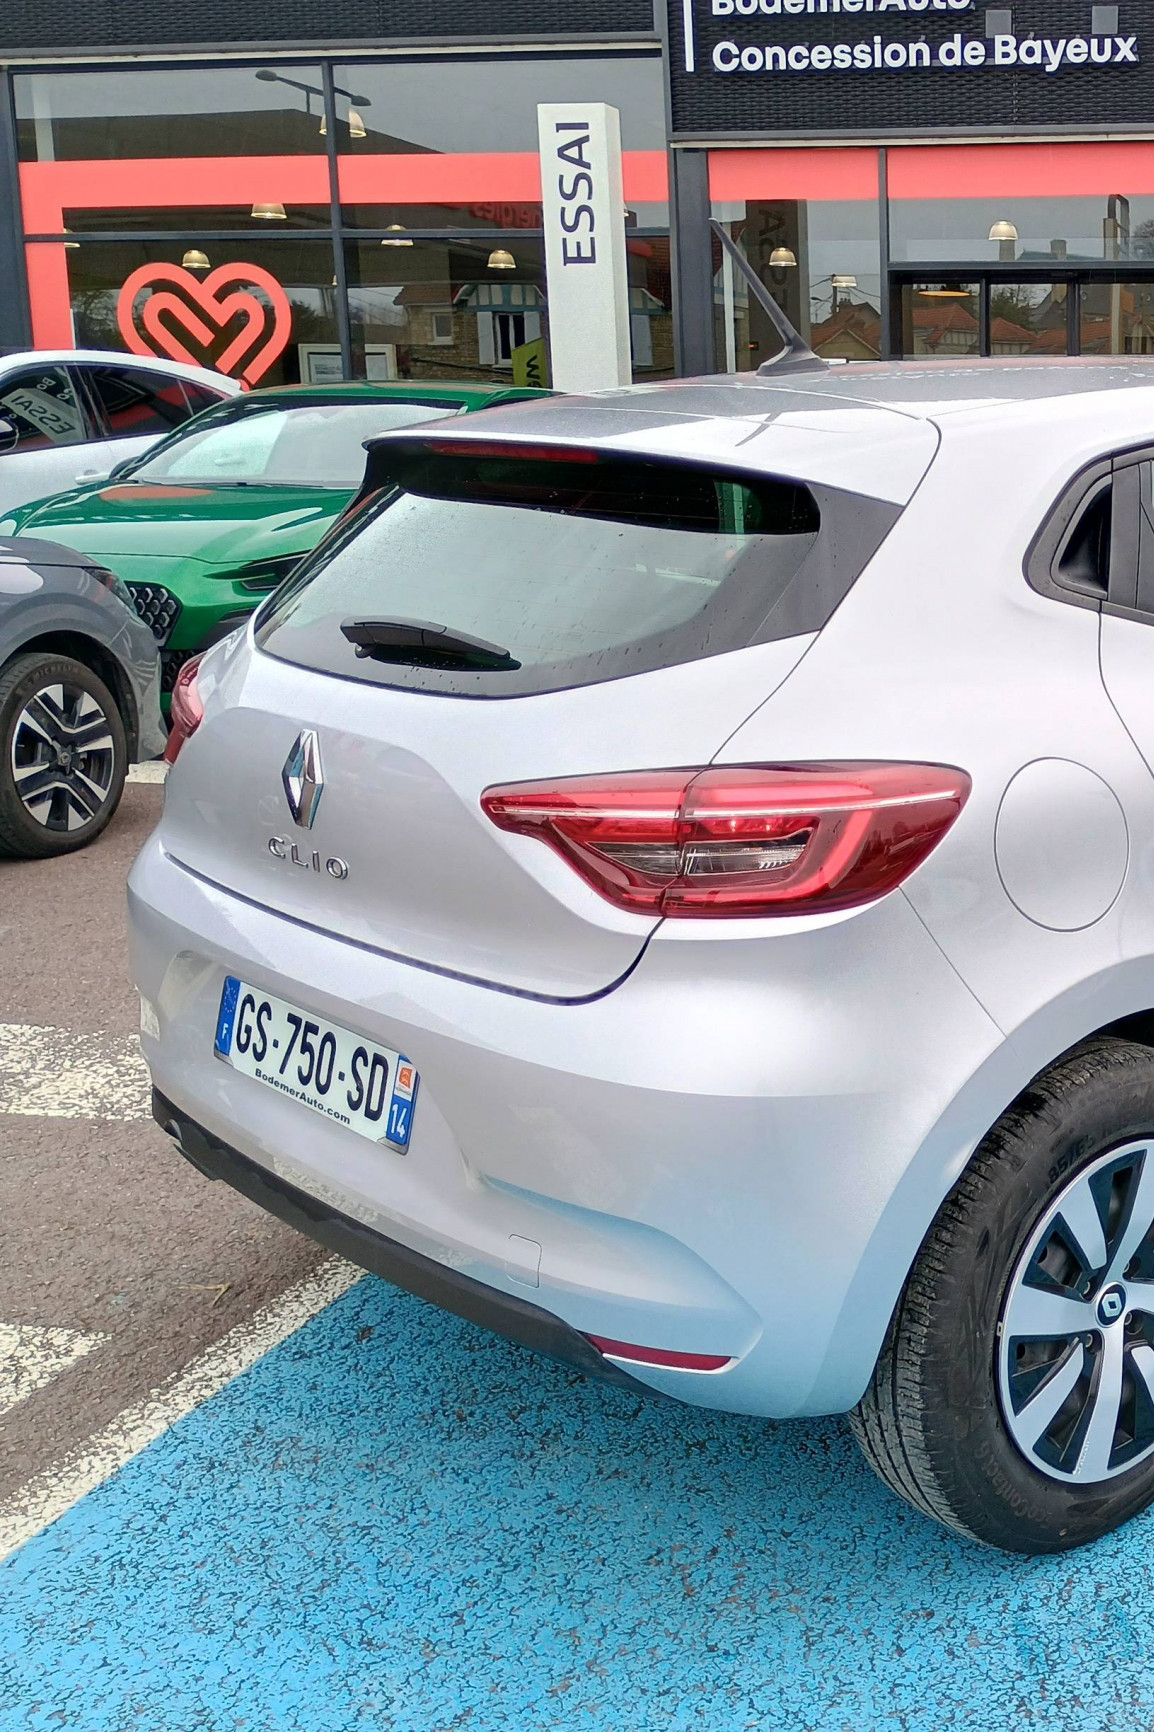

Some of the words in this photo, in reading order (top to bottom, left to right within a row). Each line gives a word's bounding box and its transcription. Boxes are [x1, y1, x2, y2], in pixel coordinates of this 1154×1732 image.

[712, 35, 930, 72] Concession
[938, 34, 986, 66] de
[994, 34, 1137, 72] Bayeux
[555, 122, 596, 266] ESSAI
[268, 836, 349, 880] CLIO
[221, 1023, 229, 1040] F
[236, 993, 389, 1122] GS-750-SD
[255, 1067, 351, 1125] BodemerAuto.com
[390, 1103, 406, 1138] 14
